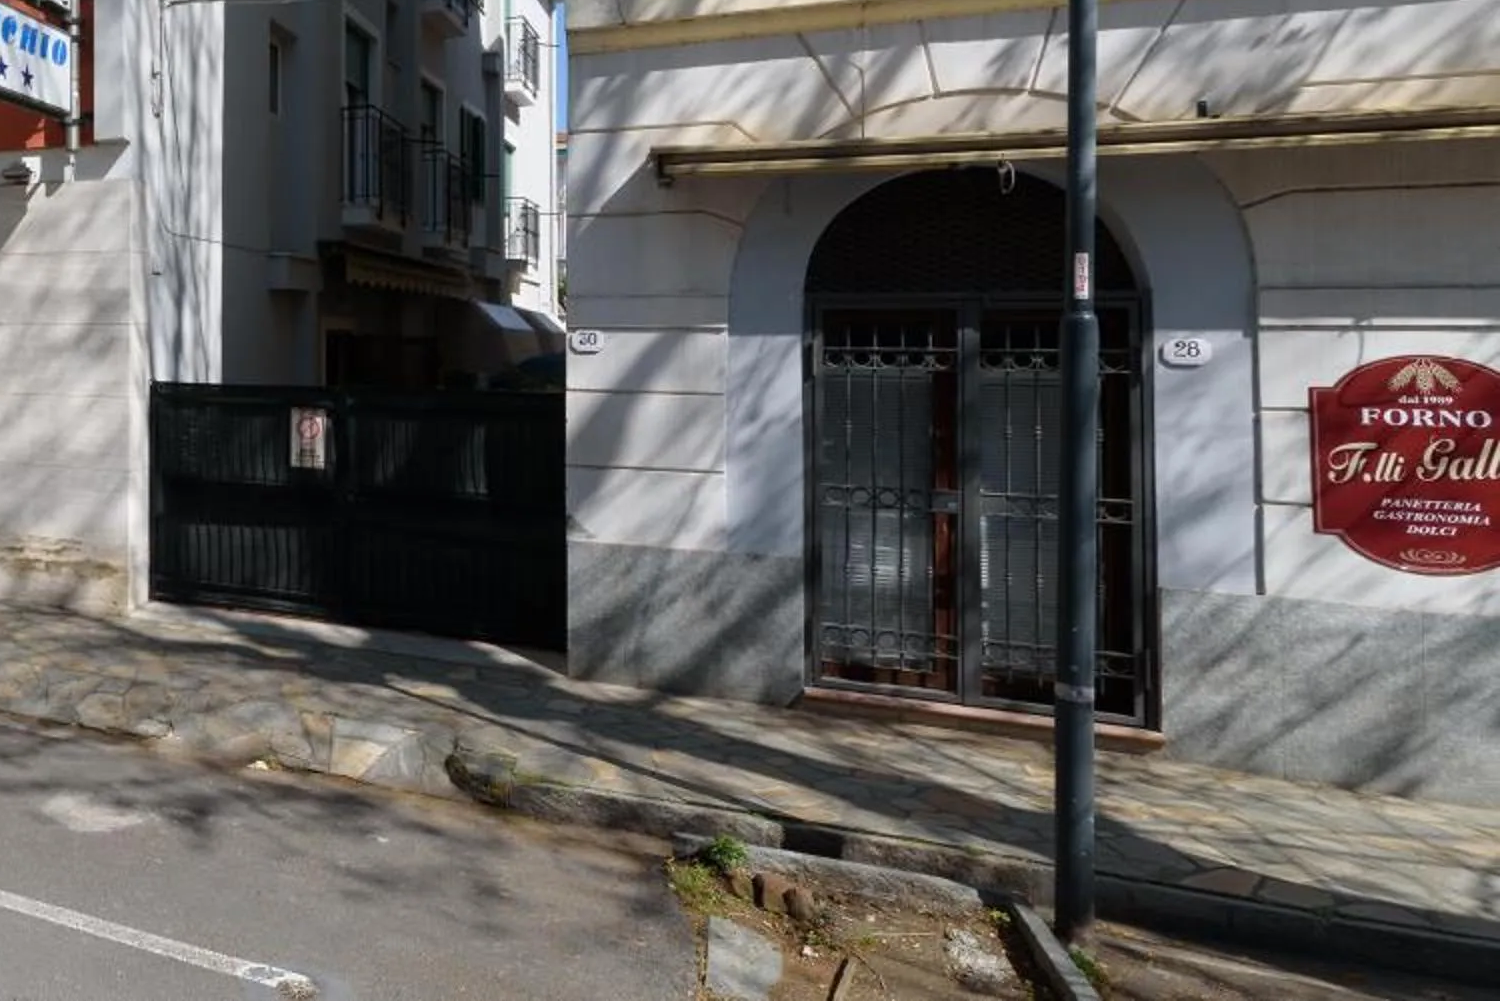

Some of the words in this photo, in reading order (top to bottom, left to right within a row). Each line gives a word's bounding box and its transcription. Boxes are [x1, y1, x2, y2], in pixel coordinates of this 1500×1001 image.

[1174, 340, 1200, 357] 28
[1361, 407, 1492, 428] FORNO
[1380, 498, 1481, 512] PANETTERIA
[1373, 510, 1490, 526] GASTRONOMIA
[1406, 525, 1457, 536] DOLCI
